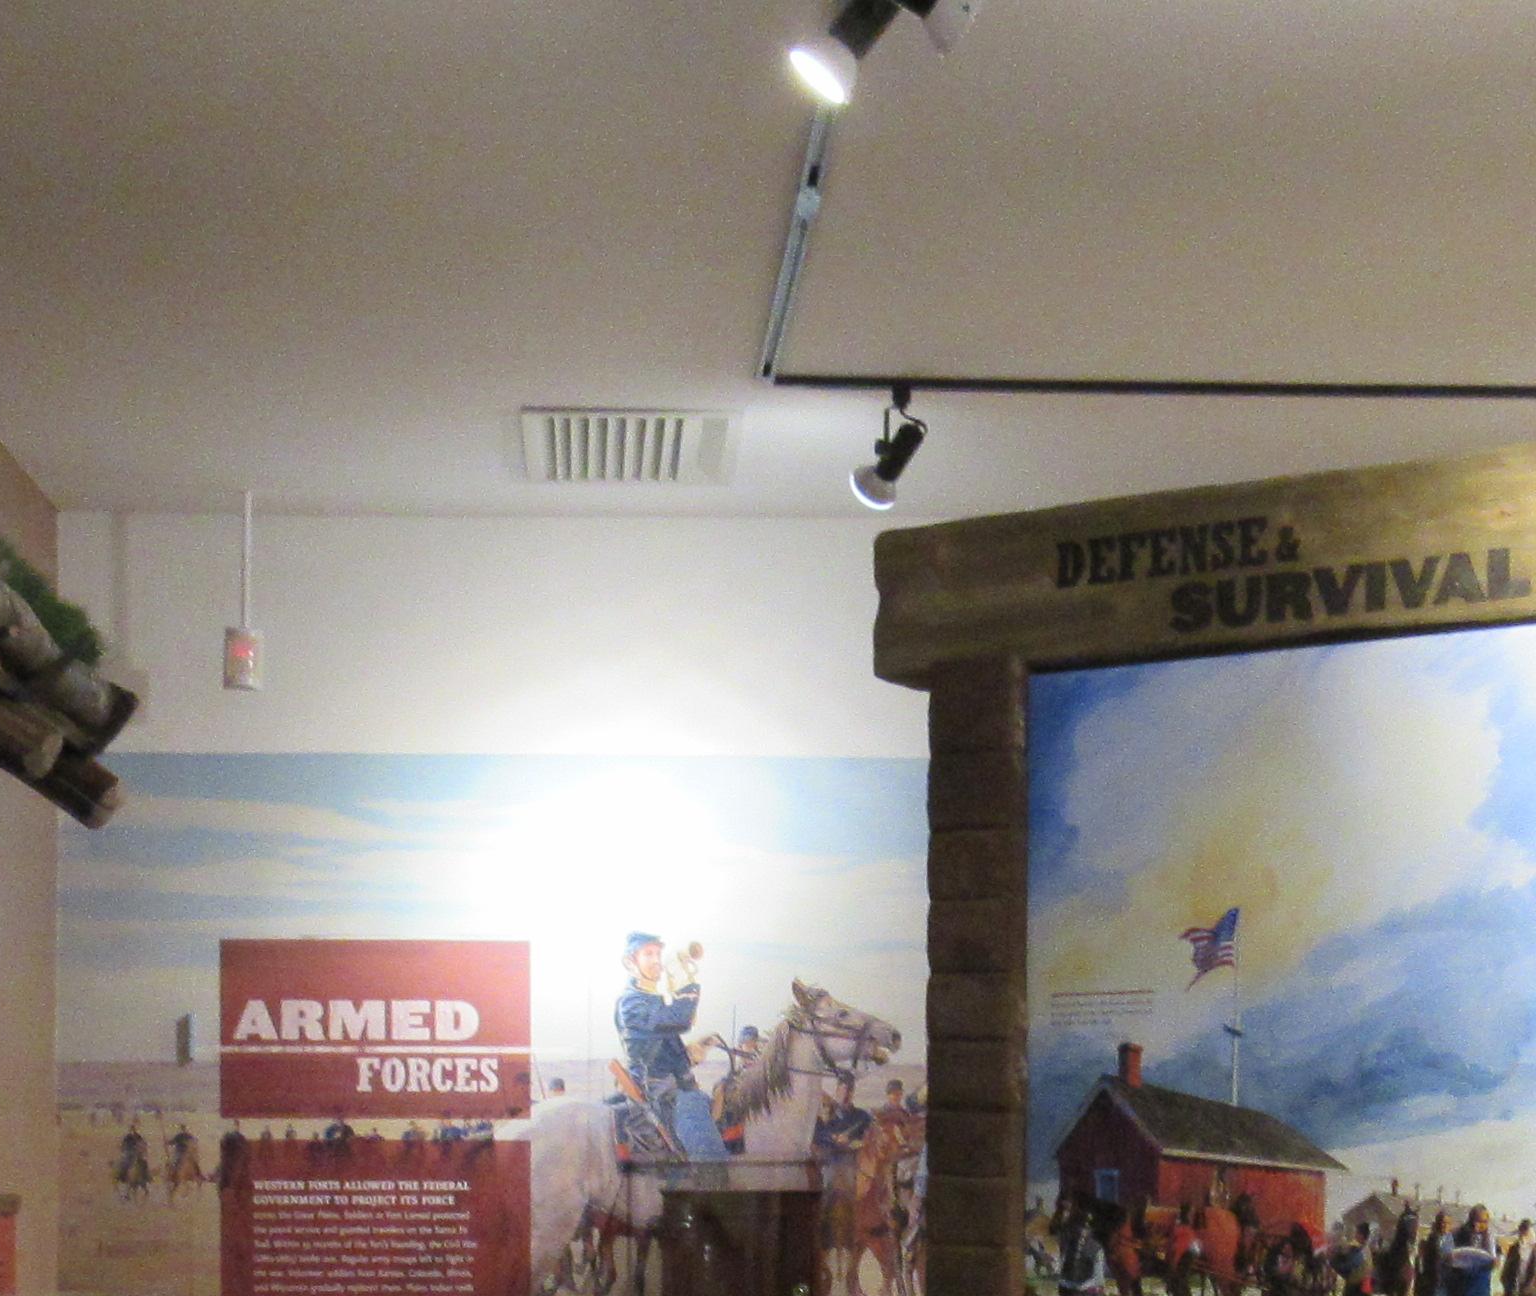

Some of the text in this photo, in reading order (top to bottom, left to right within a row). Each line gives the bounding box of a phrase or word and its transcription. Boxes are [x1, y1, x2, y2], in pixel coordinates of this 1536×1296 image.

[1055, 516, 1300, 590] DEFENSE &
[1170, 547, 1531, 635] SURVIVAL
[233, 998, 480, 1042] ARMED
[355, 1057, 500, 1094] FORCES
[253, 1179, 470, 1192] WESTERN FORTS ALLOWED THE FEDERAL
[253, 1194, 331, 1206] GOVERNMENT
[334, 1194, 349, 1206] TO
[352, 1194, 397, 1206] PROJECT
[421, 1194, 456, 1205] FORCE
